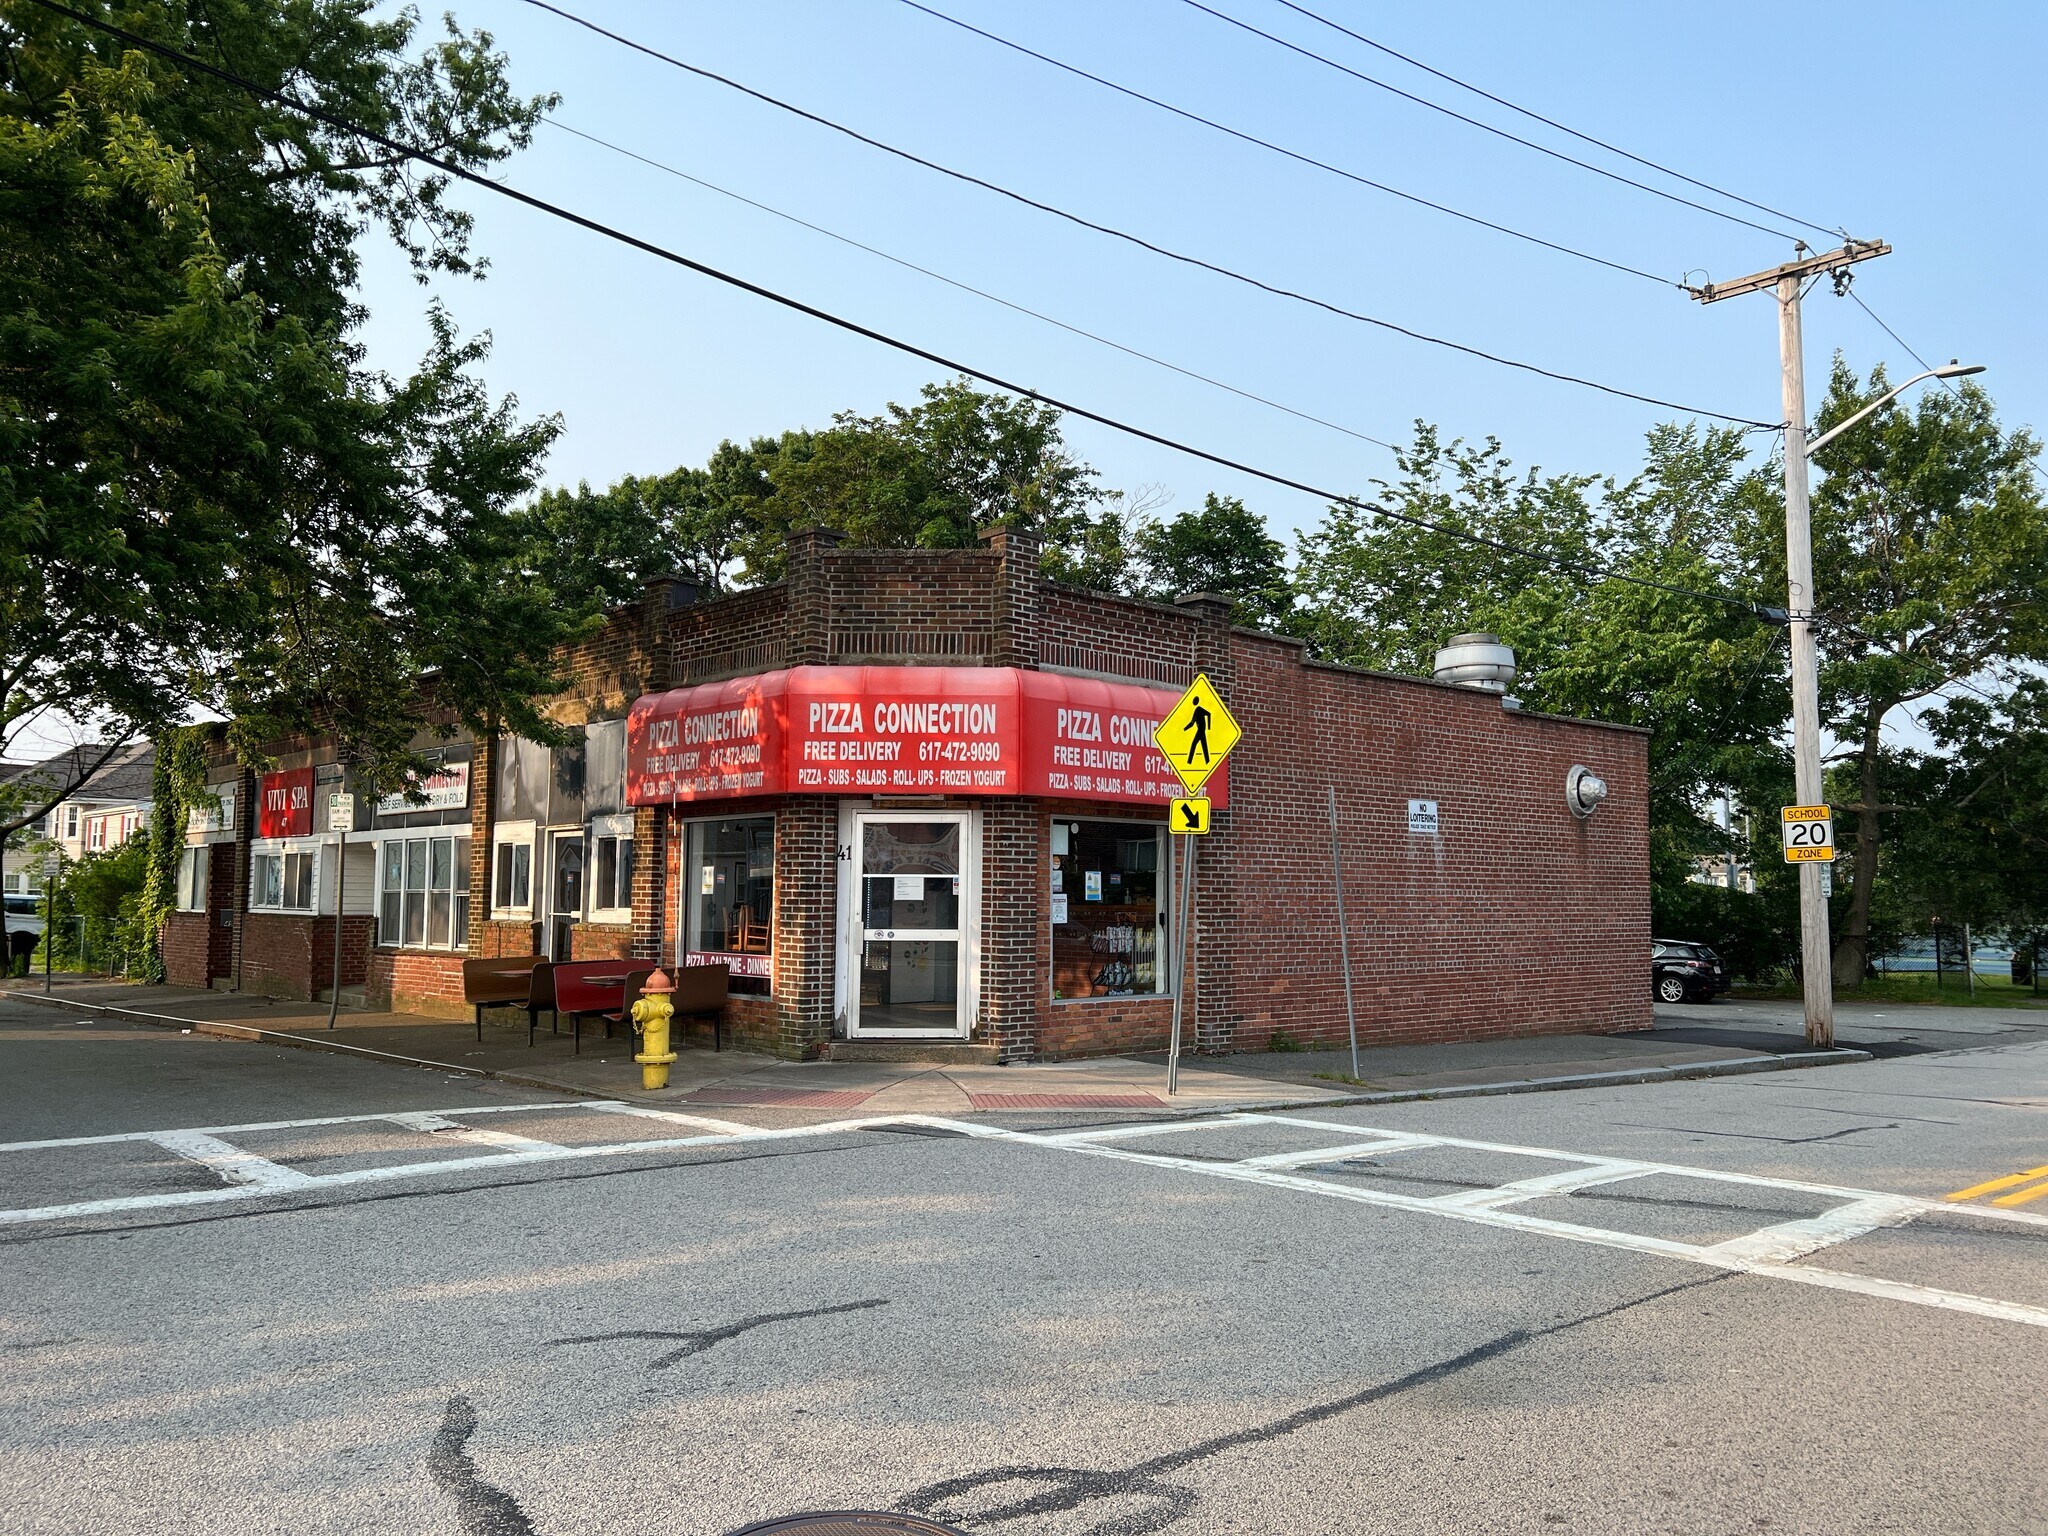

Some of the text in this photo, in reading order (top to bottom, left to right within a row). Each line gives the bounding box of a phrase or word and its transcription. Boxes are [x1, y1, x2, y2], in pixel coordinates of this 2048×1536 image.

[649, 707, 758, 750] PIZZA CONNECTION
[809, 703, 996, 734] PIZZA CONNECTION
[1057, 708, 1159, 749] PIZZA CONNE
[646, 744, 760, 774] FREE DELIVERY 617-472-9090
[804, 742, 1000, 762] FREE DELIVERY 617-472-9090
[1054, 745, 1081, 766] FREE
[1083, 748, 1132, 771] DELIVERY
[643, 782, 656, 797] PIZZA
[722, 772, 742, 789] FROZEN
[743, 771, 764, 788] YOGURT
[799, 769, 822, 785] PIZZA
[828, 769, 849, 785] SUBS
[856, 769, 887, 786] SALADS
[917, 770, 934, 786] UPS
[940, 770, 972, 786] FROZEN
[973, 770, 1006, 786] YOGURT
[1048, 772, 1069, 790] PIZZA
[1073, 775, 1092, 792] SUBS
[1096, 776, 1121, 794] SALADS
[1143, 782, 1156, 797] UPS
[1160, 782, 1183, 799] FROZEN
[267, 785, 308, 811] VIVI SPA
[379, 799, 391, 811] SELF
[449, 792, 464, 804] FOLD
[1419, 803, 1427, 812] NO
[1410, 813, 1437, 823] LOITERING
[1787, 809, 1825, 819] SCHOOL
[1792, 823, 1826, 846] 20
[837, 844, 851, 861] 41
[1797, 849, 1823, 858] ZONE
